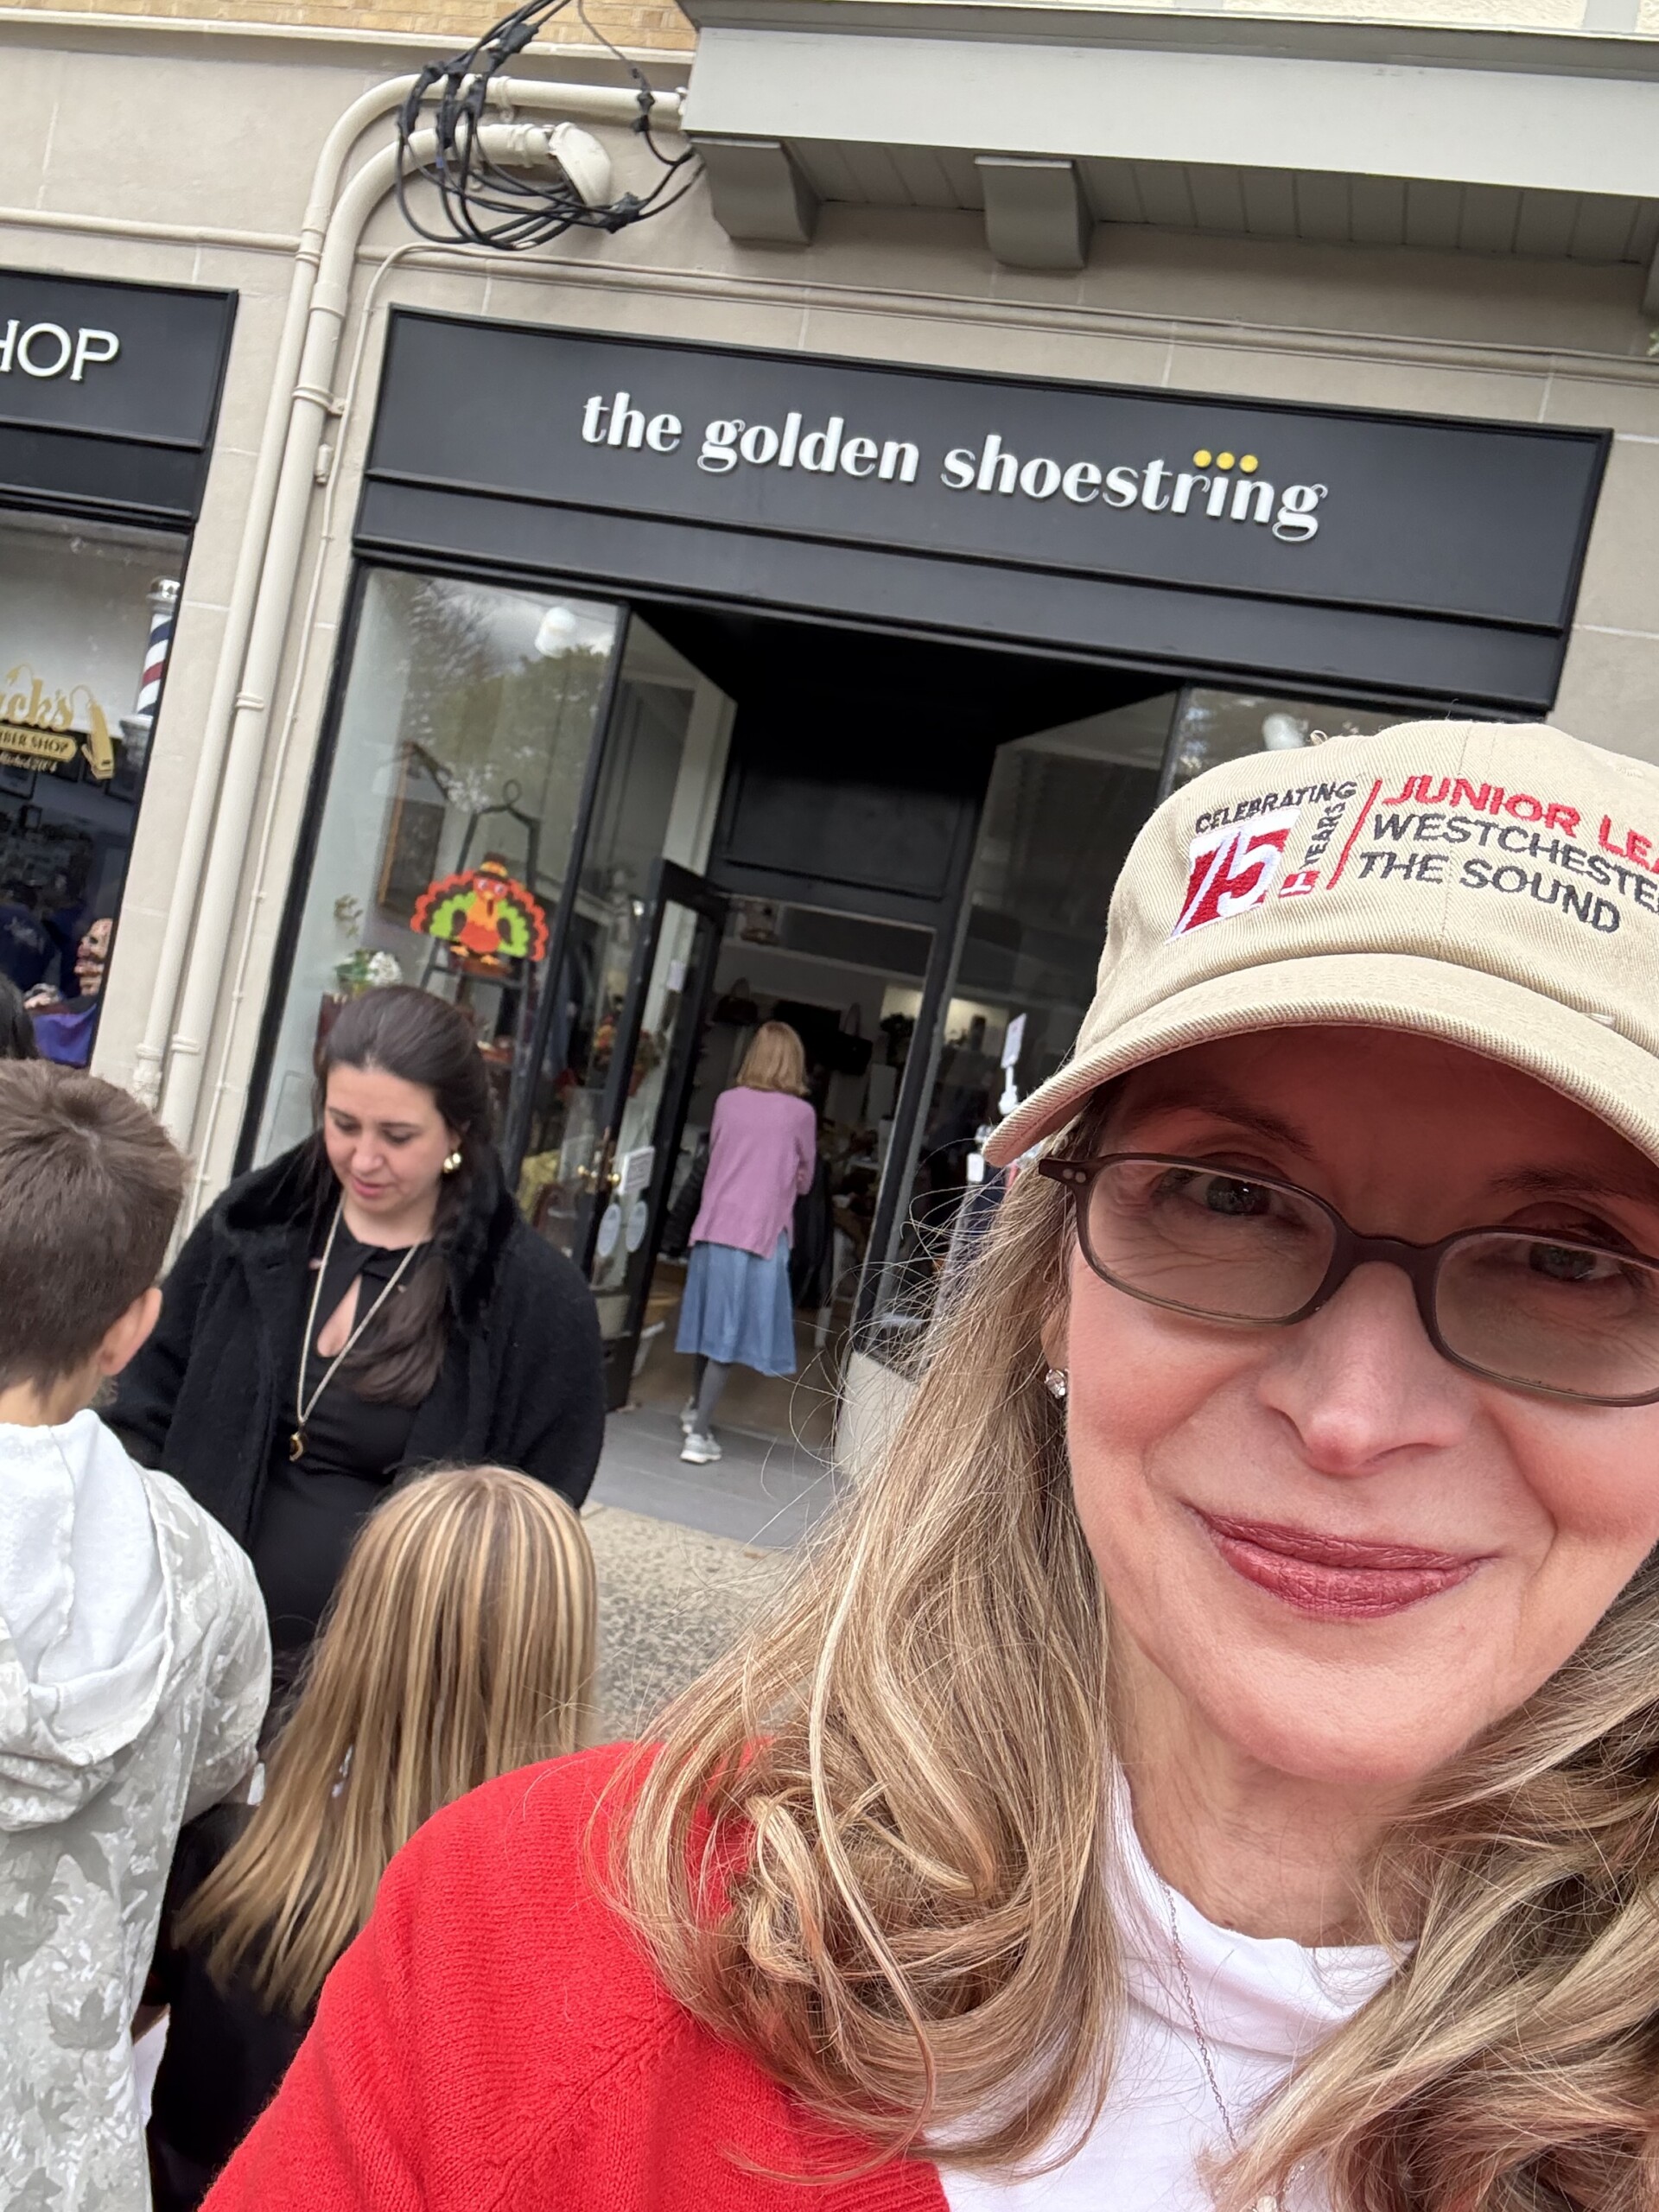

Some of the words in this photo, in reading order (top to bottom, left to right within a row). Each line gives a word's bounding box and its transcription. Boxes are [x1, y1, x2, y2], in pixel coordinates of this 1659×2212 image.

[581, 391, 683, 453] the
[696, 410, 920, 483] golden
[0, 730, 28, 747] BER
[31, 734, 69, 753] SHOP
[1195, 780, 1357, 835] CELEBRATING
[1299, 802, 1346, 870] YEARS
[1382, 774, 1581, 839] JUNIOR
[1598, 814, 1659, 876] LE
[1166, 807, 1301, 942] 75
[1357, 851, 1450, 885] THE
[1459, 857, 1621, 933] SOUND
[1373, 812, 1659, 916] WESTCHESTE
